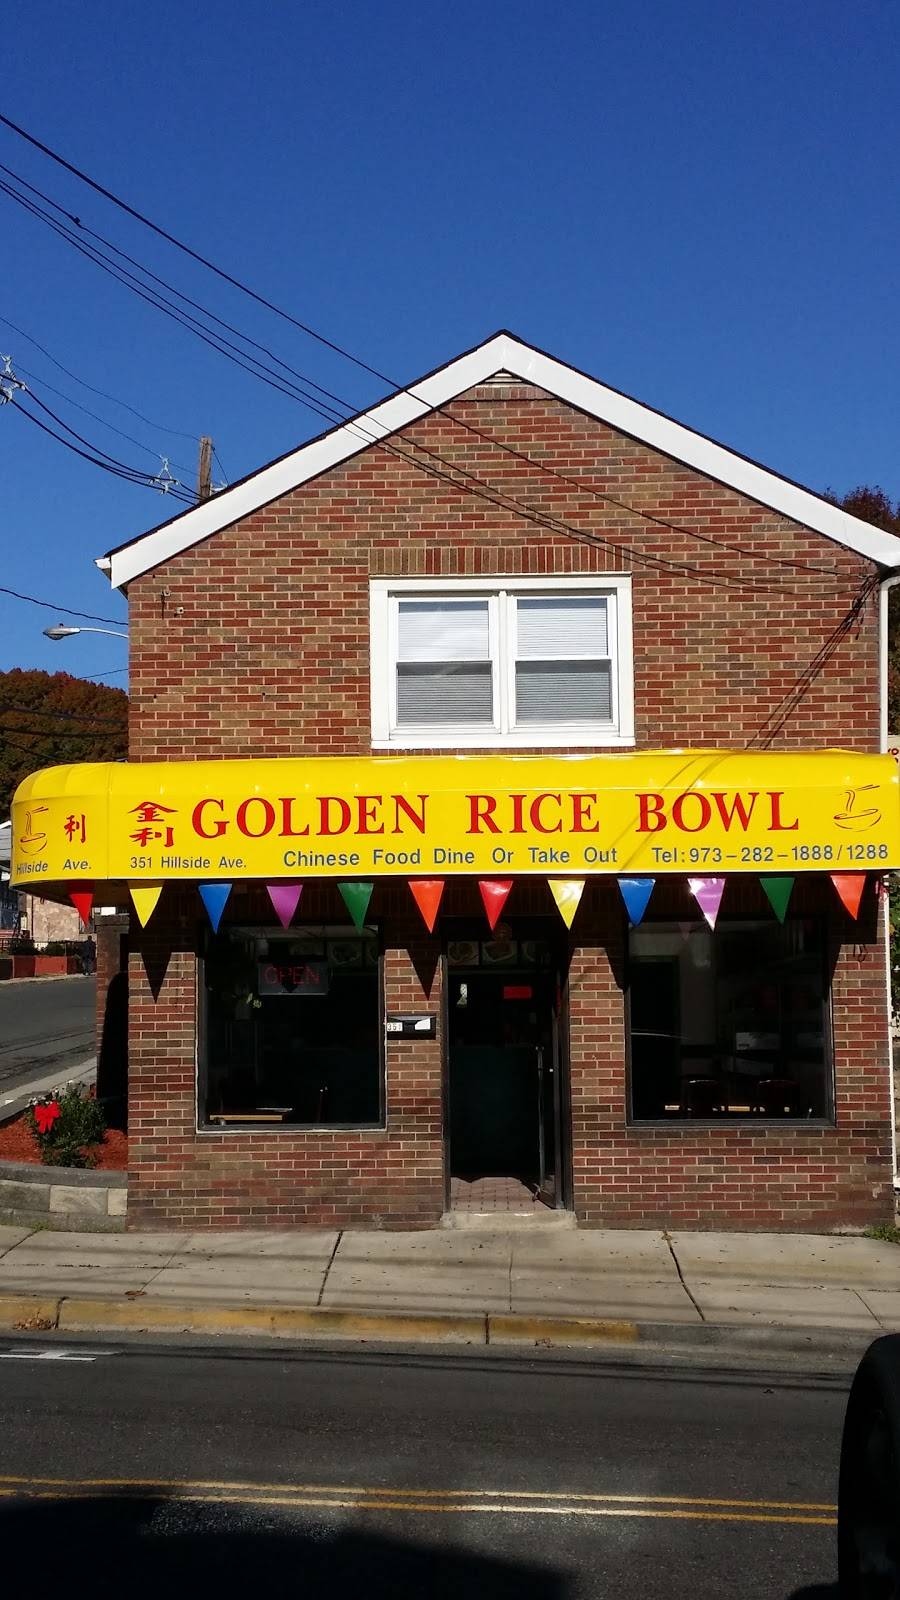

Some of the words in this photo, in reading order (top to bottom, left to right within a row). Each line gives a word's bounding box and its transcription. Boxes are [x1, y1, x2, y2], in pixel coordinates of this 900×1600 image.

[191, 794, 430, 840] GOLDEN
[464, 793, 600, 834] RICE
[634, 790, 800, 833] BOWL
[63, 813, 87, 844] 利
[130, 856, 152, 869] 351
[160, 856, 212, 869] Hillside
[218, 856, 247, 869] Ave.
[283, 849, 360, 867] Chinese
[372, 847, 421, 865] Food
[433, 847, 475, 864] Dine
[492, 846, 514, 864] Or
[527, 846, 570, 864] Take
[583, 845, 618, 863] Out
[15, 859, 49, 877] Hillside
[62, 858, 92, 872] Ave.
[263, 964, 321, 986] OPEN
